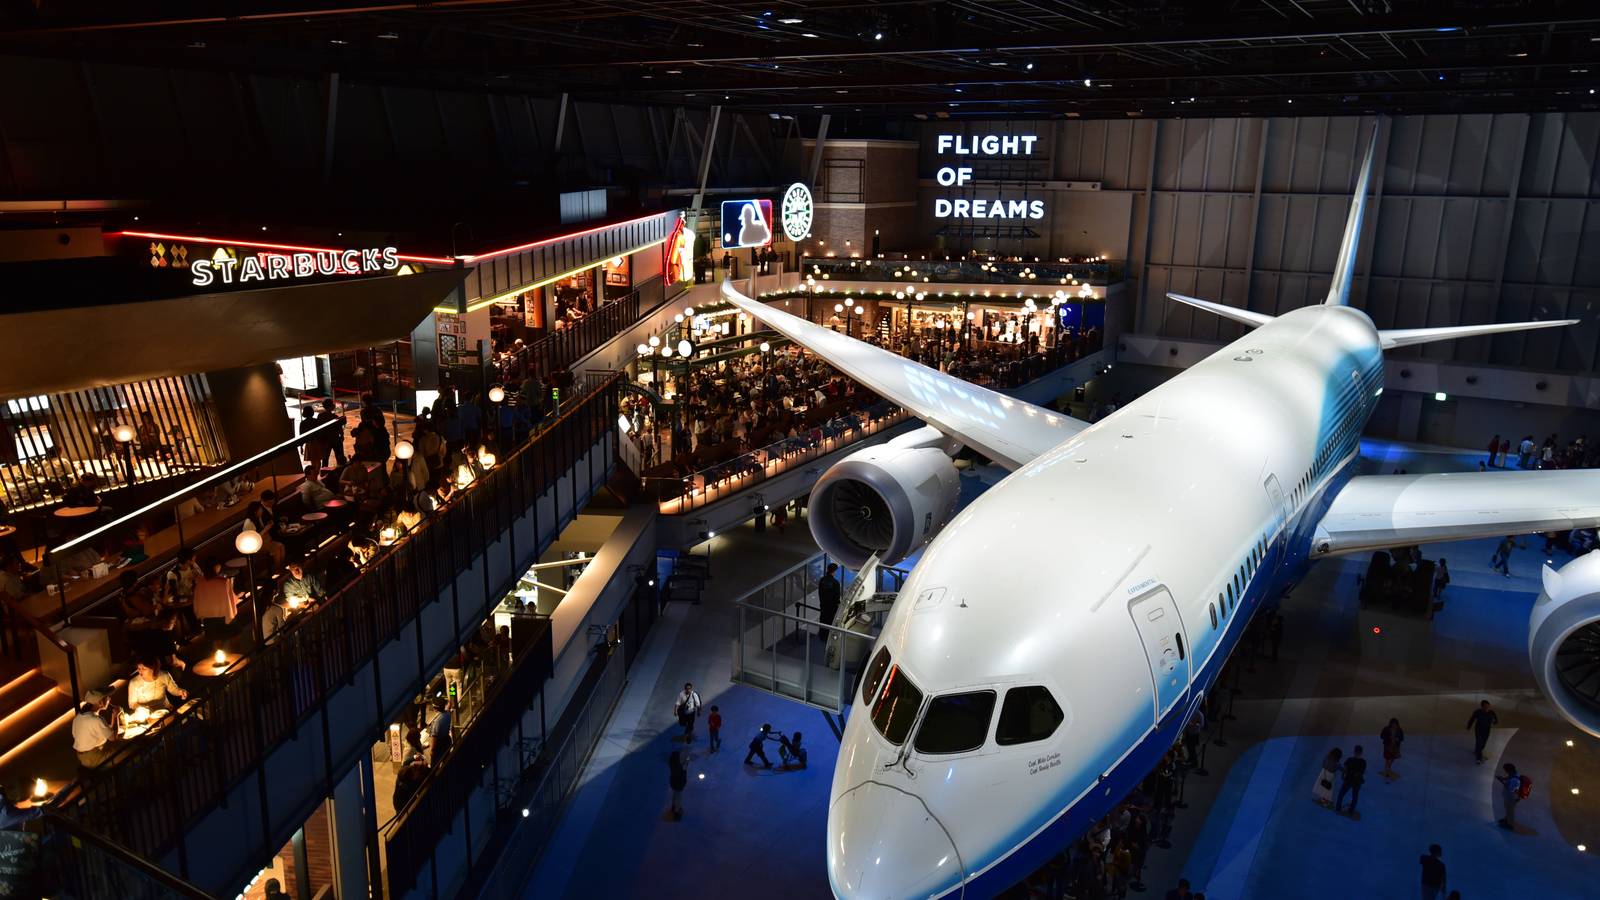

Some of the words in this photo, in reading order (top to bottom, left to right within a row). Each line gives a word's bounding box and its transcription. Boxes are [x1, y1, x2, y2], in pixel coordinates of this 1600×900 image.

[938, 135, 1038, 155] FLIGHT
[936, 167, 973, 187] OF
[935, 199, 1045, 219] DREAMS
[192, 247, 399, 286] STARBUCKS
